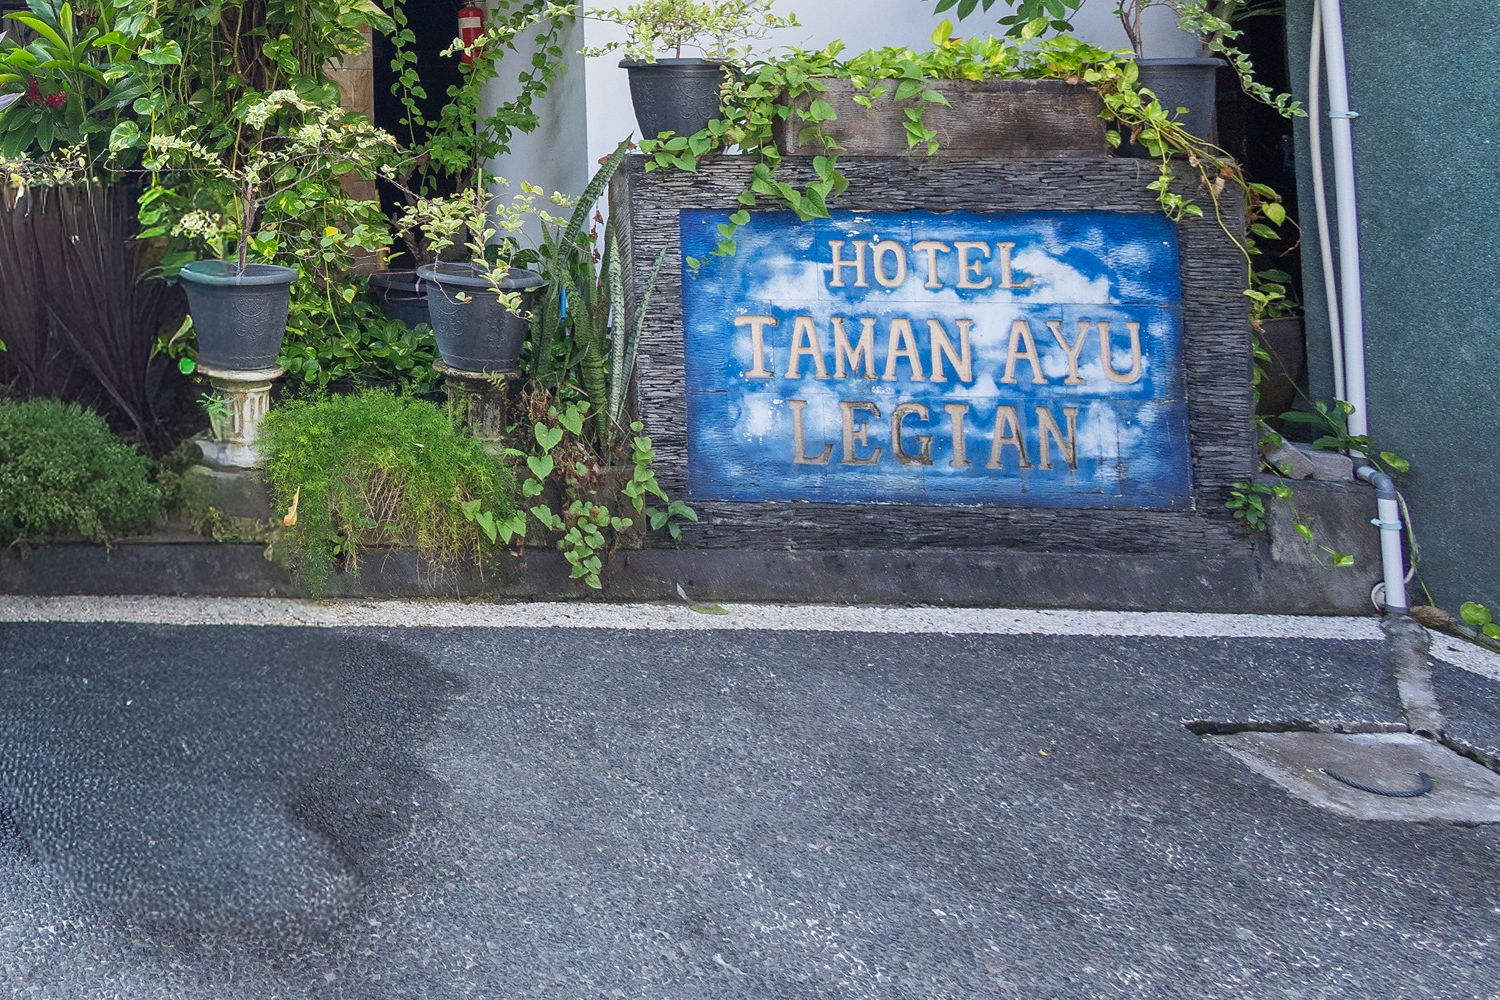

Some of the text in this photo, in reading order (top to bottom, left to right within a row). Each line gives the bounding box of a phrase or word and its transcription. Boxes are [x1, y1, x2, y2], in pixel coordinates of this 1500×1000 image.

[829, 239, 1034, 290] HOTEL
[734, 314, 1143, 385] TAMAN AYU
[787, 400, 1079, 470] LEGIAN
